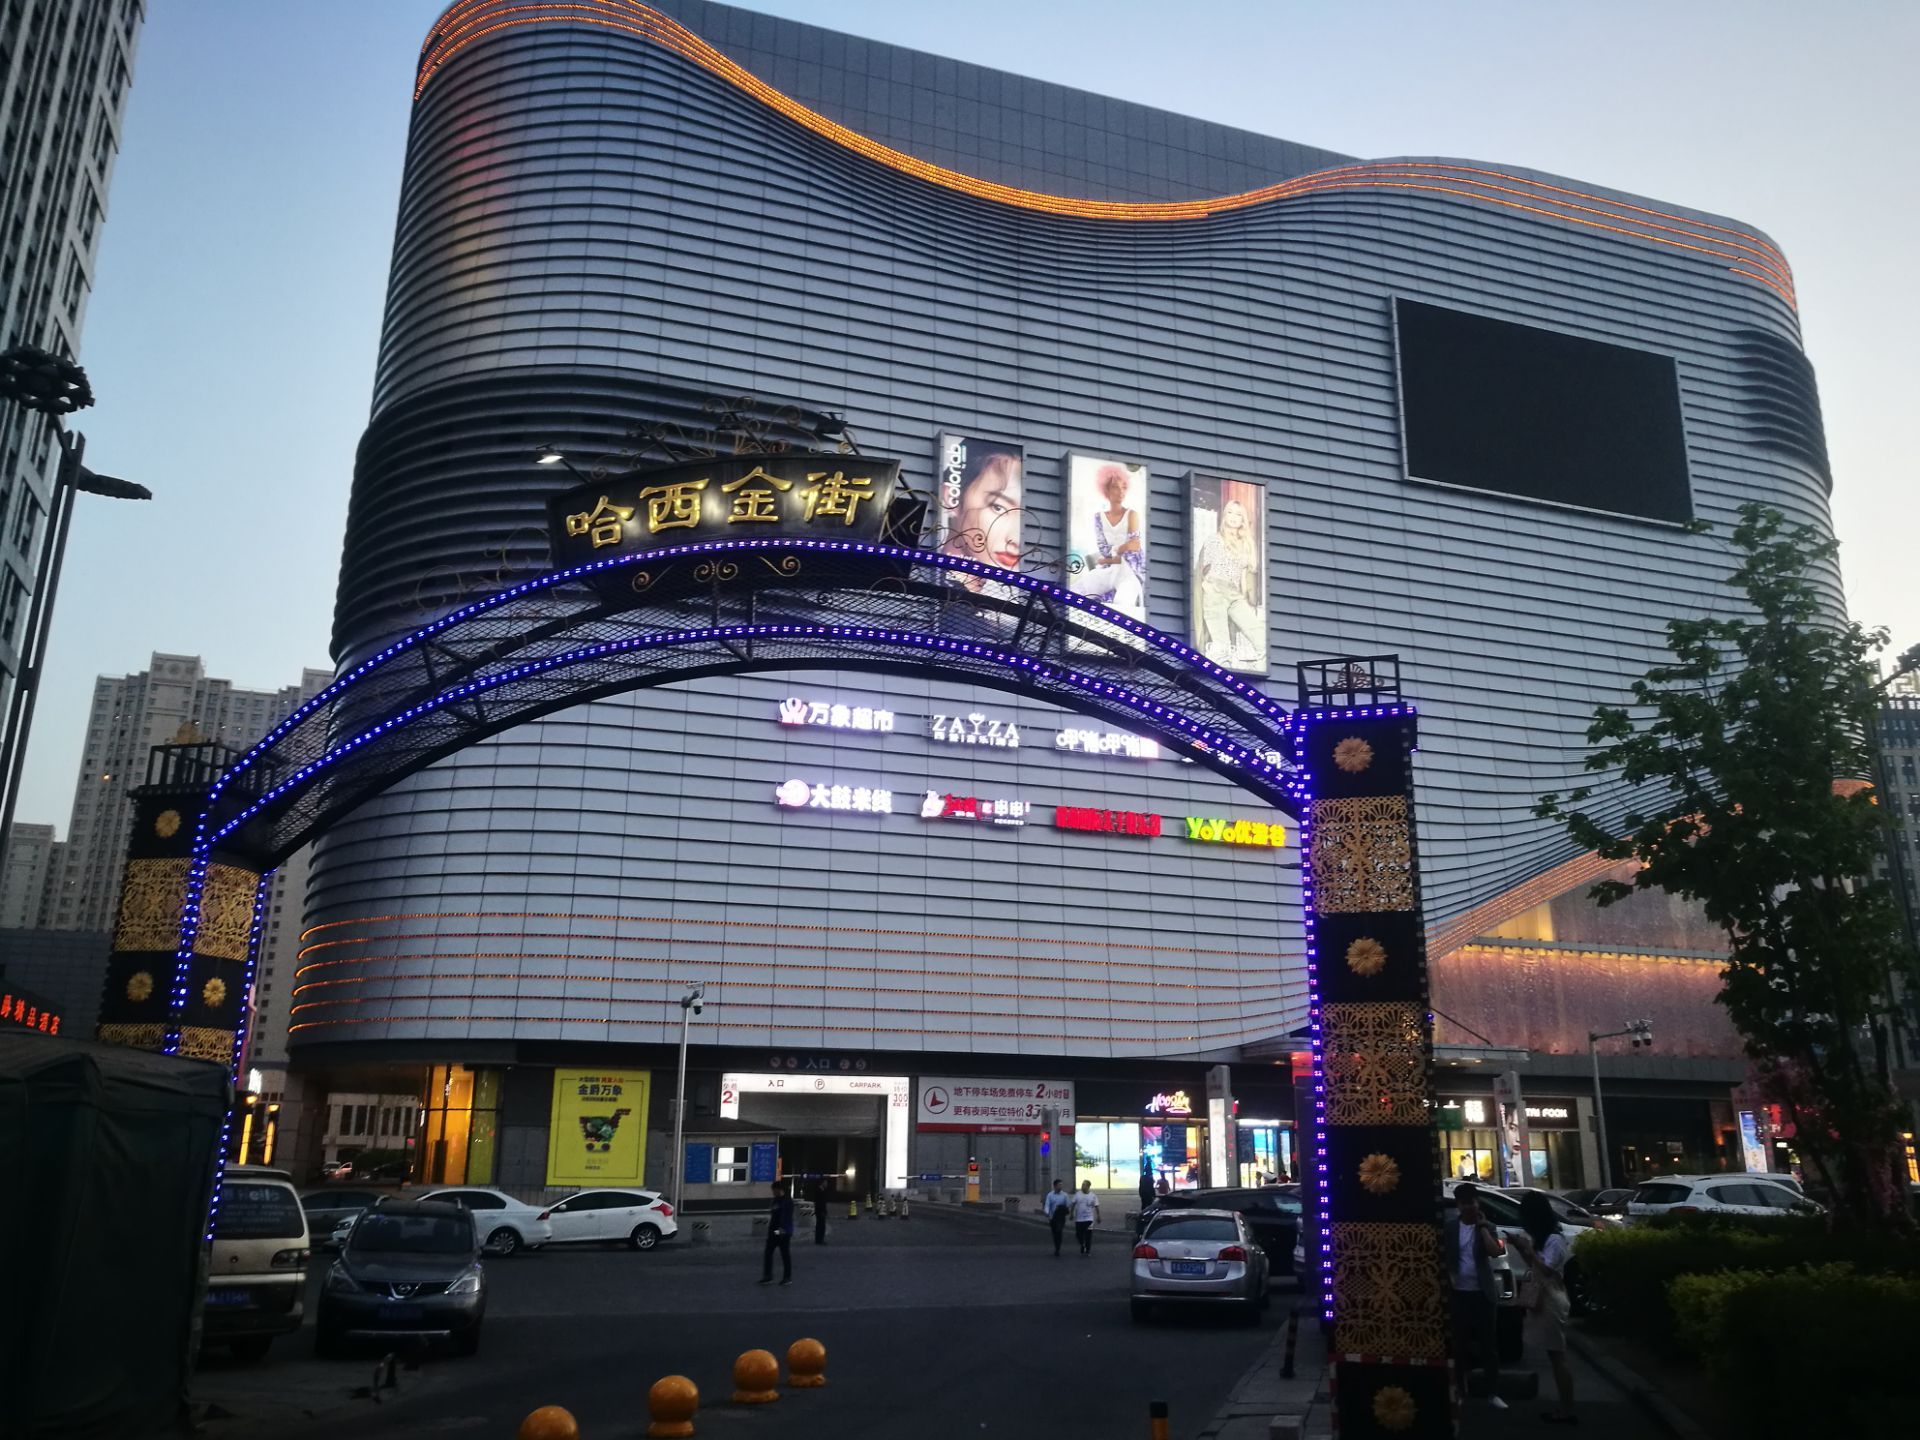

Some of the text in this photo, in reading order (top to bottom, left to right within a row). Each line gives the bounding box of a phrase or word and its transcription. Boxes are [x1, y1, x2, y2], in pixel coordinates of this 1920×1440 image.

[943, 443, 962, 509] colorlab
[565, 465, 876, 549] 哈西金街
[808, 701, 894, 732] 万象超市
[805, 1057, 830, 1070] 入口
[767, 1079, 784, 1088] 入口
[849, 1081, 882, 1089] CARPARK
